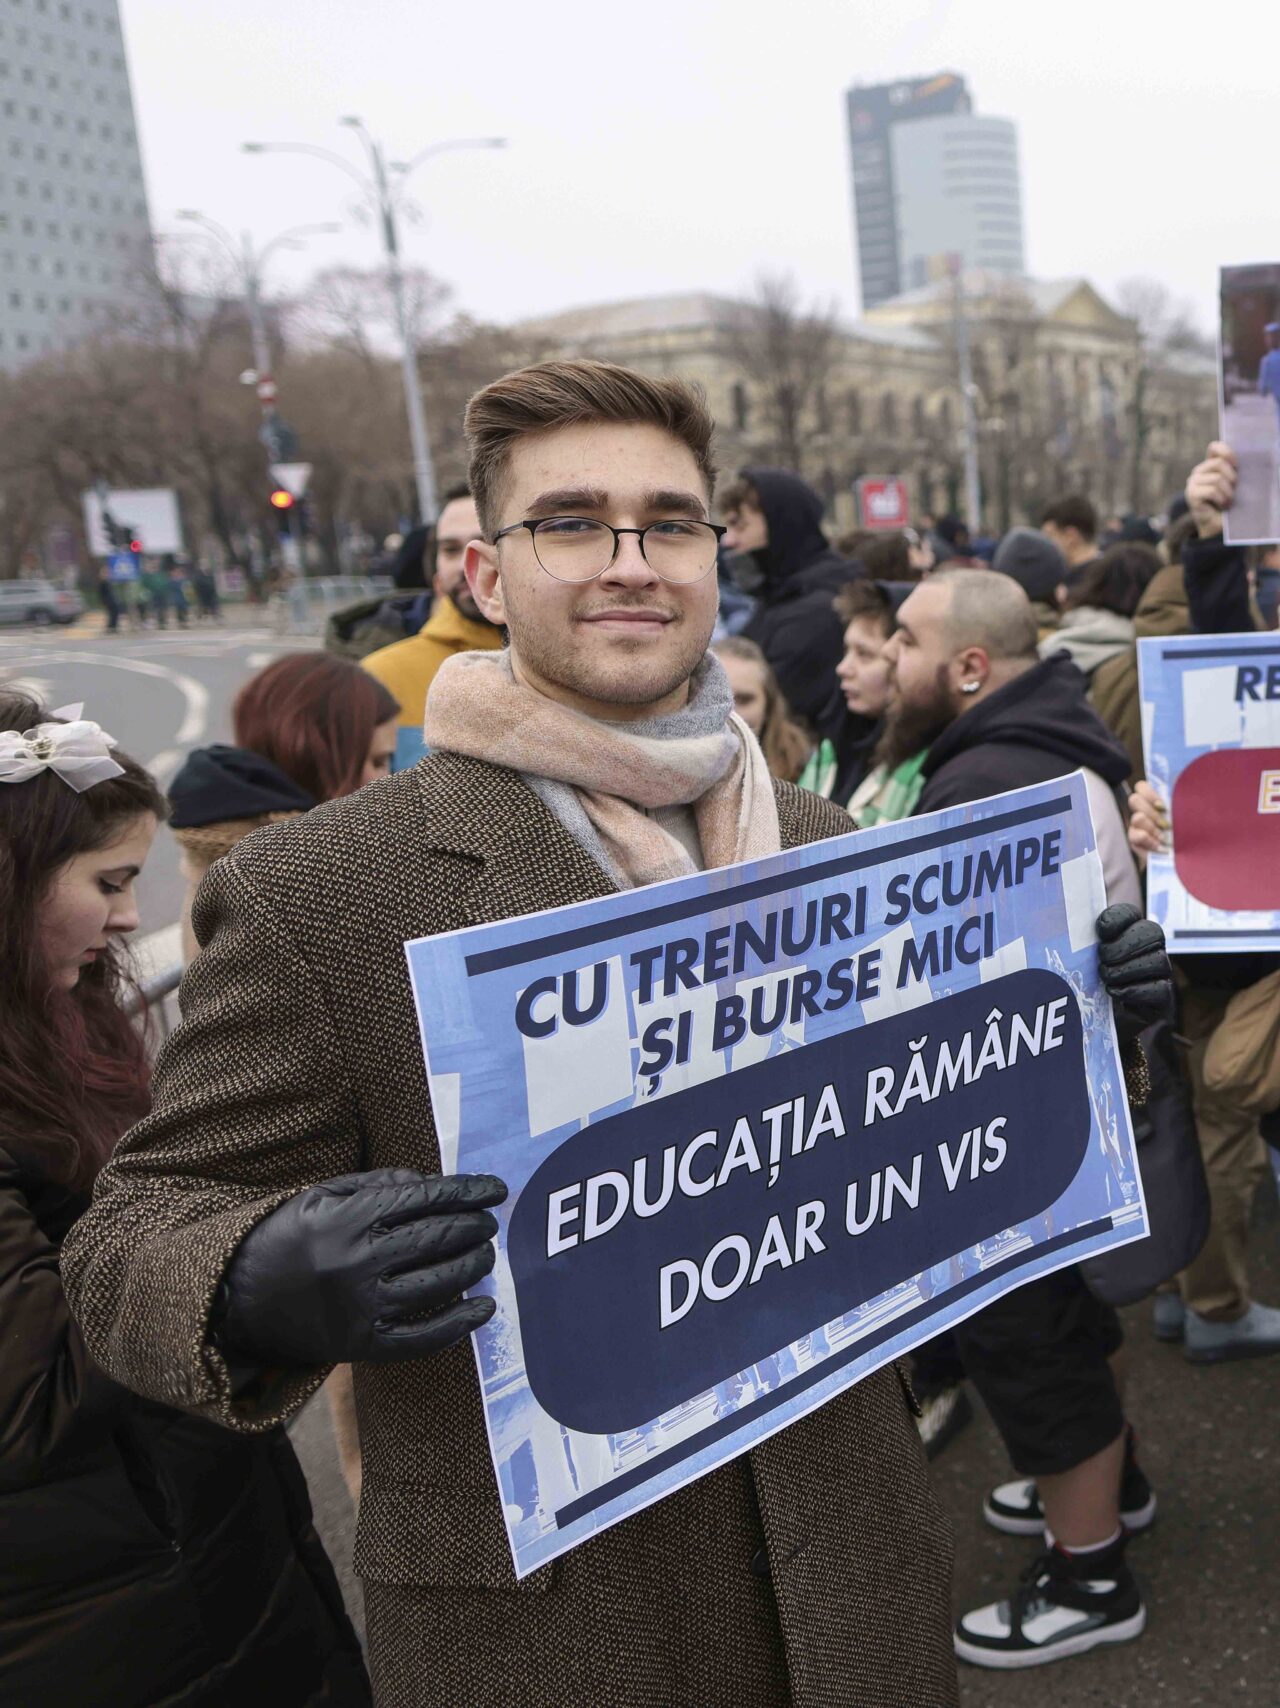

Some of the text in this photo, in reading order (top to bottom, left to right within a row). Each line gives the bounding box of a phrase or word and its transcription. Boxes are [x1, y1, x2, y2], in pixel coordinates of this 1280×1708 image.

[514, 828, 1062, 1039] CU TRENURI SCUMPE
[637, 912, 995, 1097] ȘI BURSE MICI
[546, 996, 1071, 1260] EDUCAȚIA RĂMÂNE
[659, 1115, 1010, 1331] DOAR UN VIS
